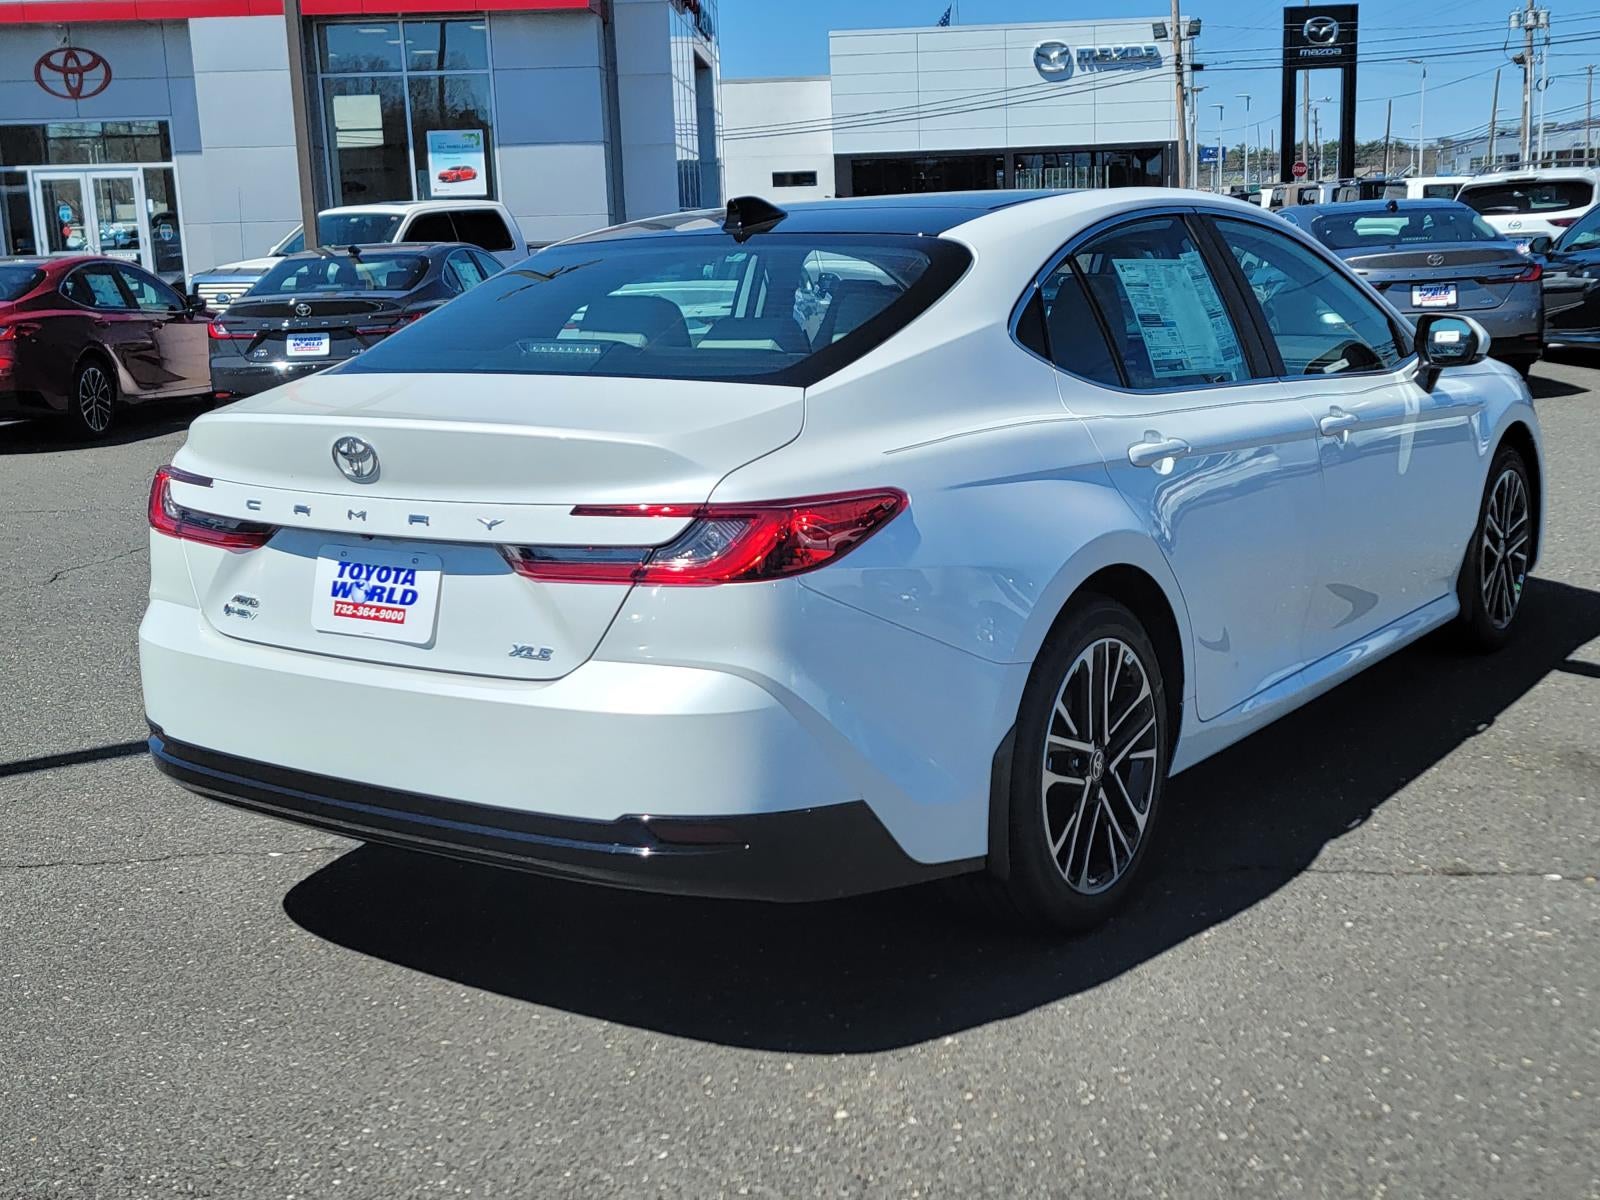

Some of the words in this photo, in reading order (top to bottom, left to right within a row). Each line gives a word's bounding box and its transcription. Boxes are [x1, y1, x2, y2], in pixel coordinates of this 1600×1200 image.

[246, 499, 505, 531] CAMRY
[337, 561, 416, 586] TOYOTA
[335, 604, 404, 621] 732-364-9000
[508, 644, 554, 662] XLE
